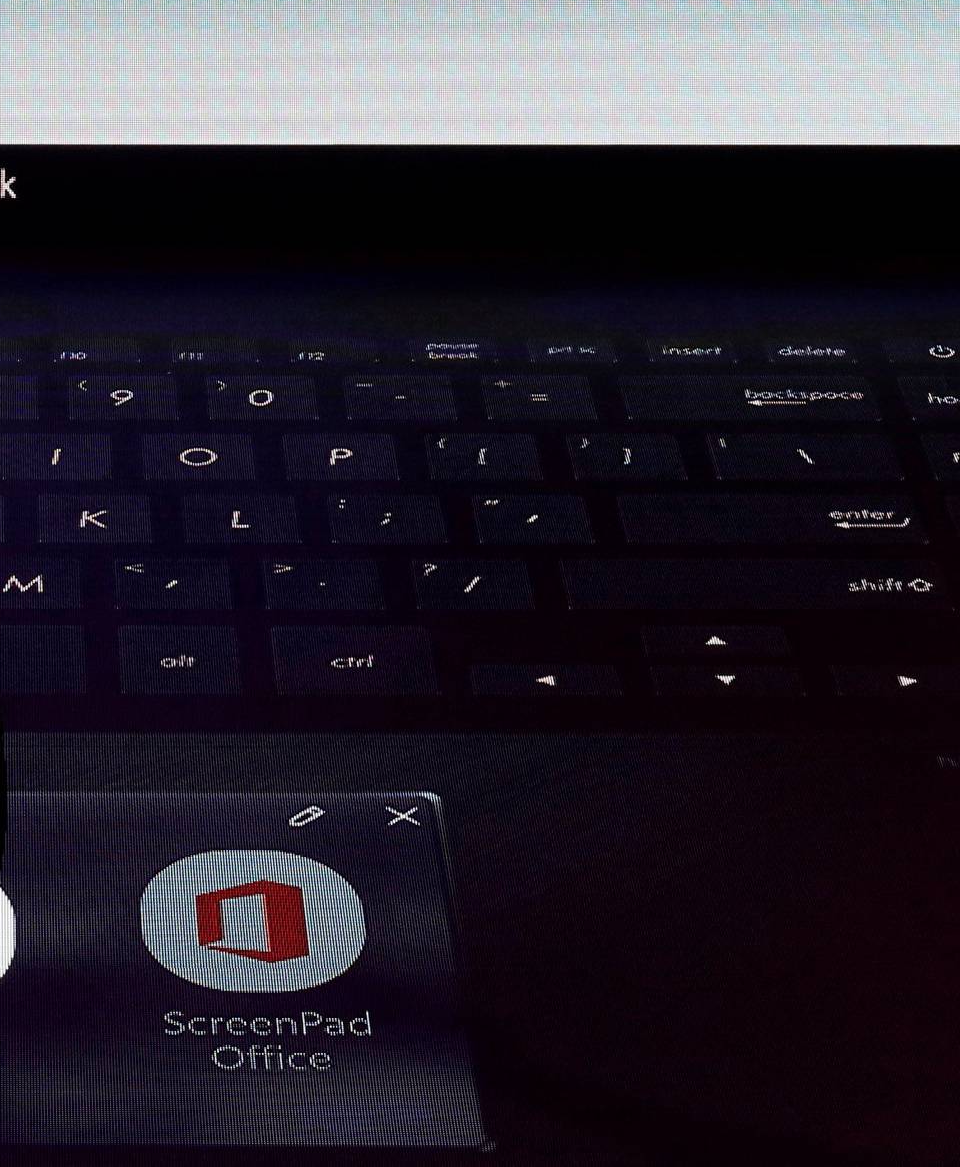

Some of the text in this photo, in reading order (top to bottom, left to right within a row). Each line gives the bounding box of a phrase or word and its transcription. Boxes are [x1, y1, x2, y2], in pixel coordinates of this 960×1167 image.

[779, 346, 845, 355] delete
[110, 390, 133, 405] 9
[745, 389, 864, 401] backspace
[180, 448, 217, 466] O
[330, 449, 352, 465] P
[80, 511, 106, 527] K
[232, 511, 249, 528] L
[830, 510, 893, 519] enter
[3, 576, 43, 592] M
[849, 578, 902, 591] shift
[161, 655, 194, 667] alt
[331, 656, 373, 668] ctrl
[164, 1011, 371, 1035] ScreenPad
[212, 1045, 330, 1070] Office
